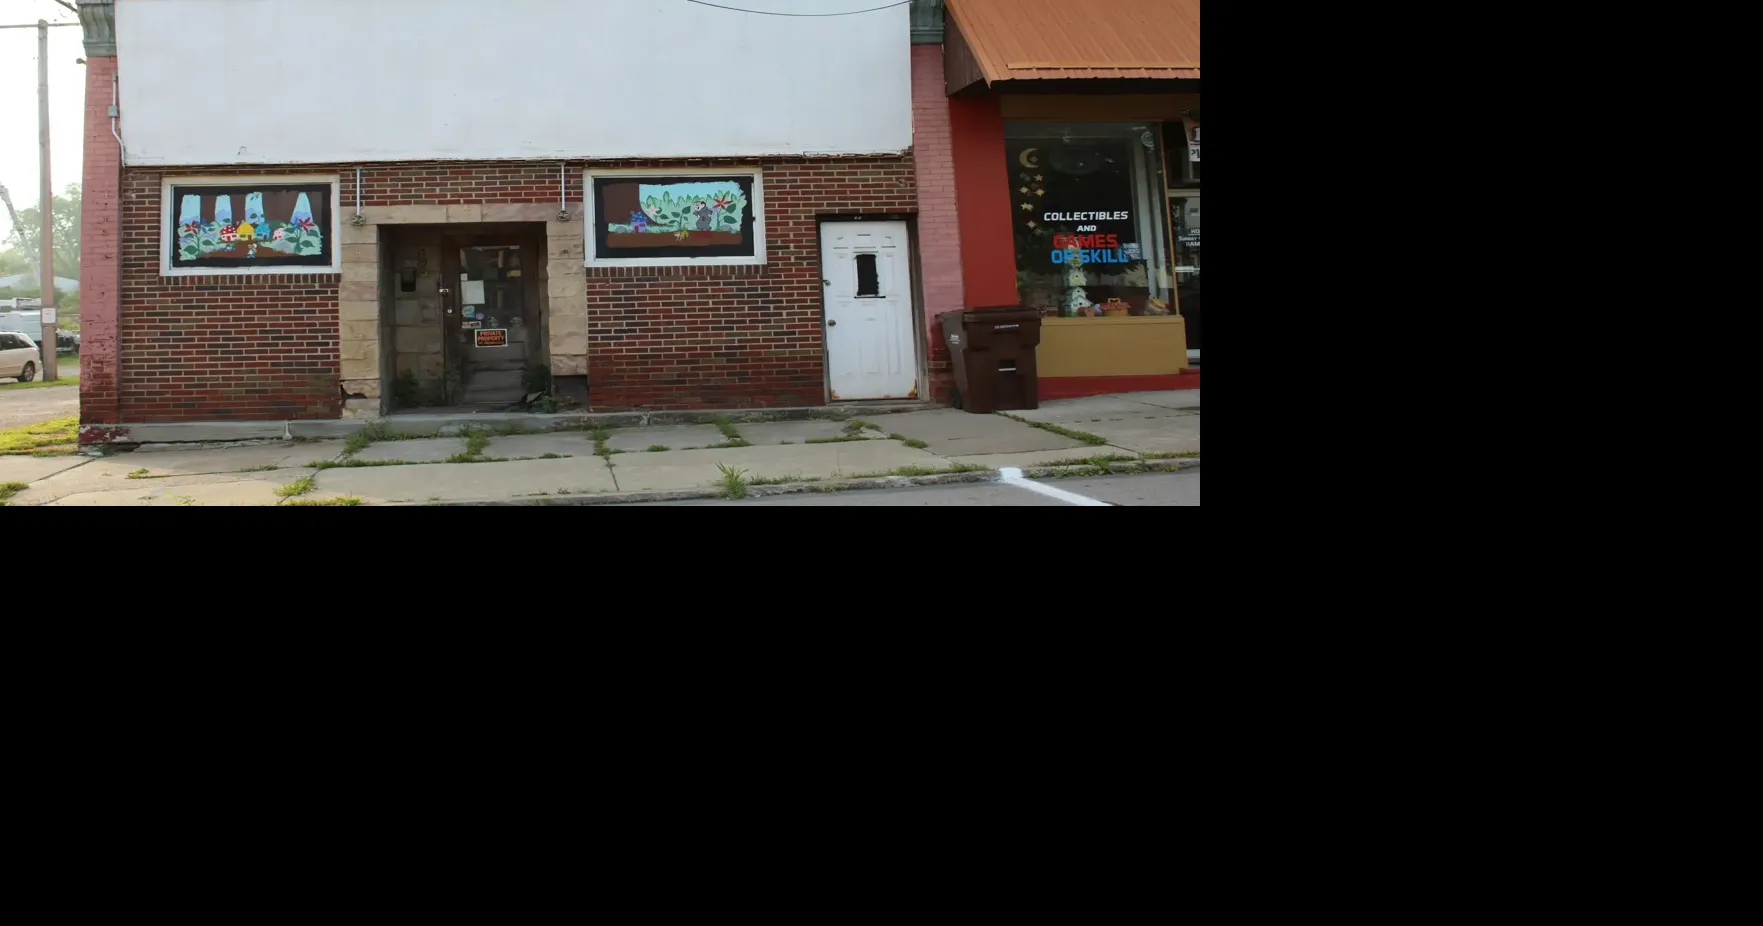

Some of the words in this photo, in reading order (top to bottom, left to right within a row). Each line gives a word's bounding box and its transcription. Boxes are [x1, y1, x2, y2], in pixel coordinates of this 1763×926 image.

[1044, 211, 1129, 221] COLLECTIBLES
[1053, 234, 1118, 248] GAMES
[1051, 249, 1073, 263] OF
[1079, 249, 1128, 263] SKILL
